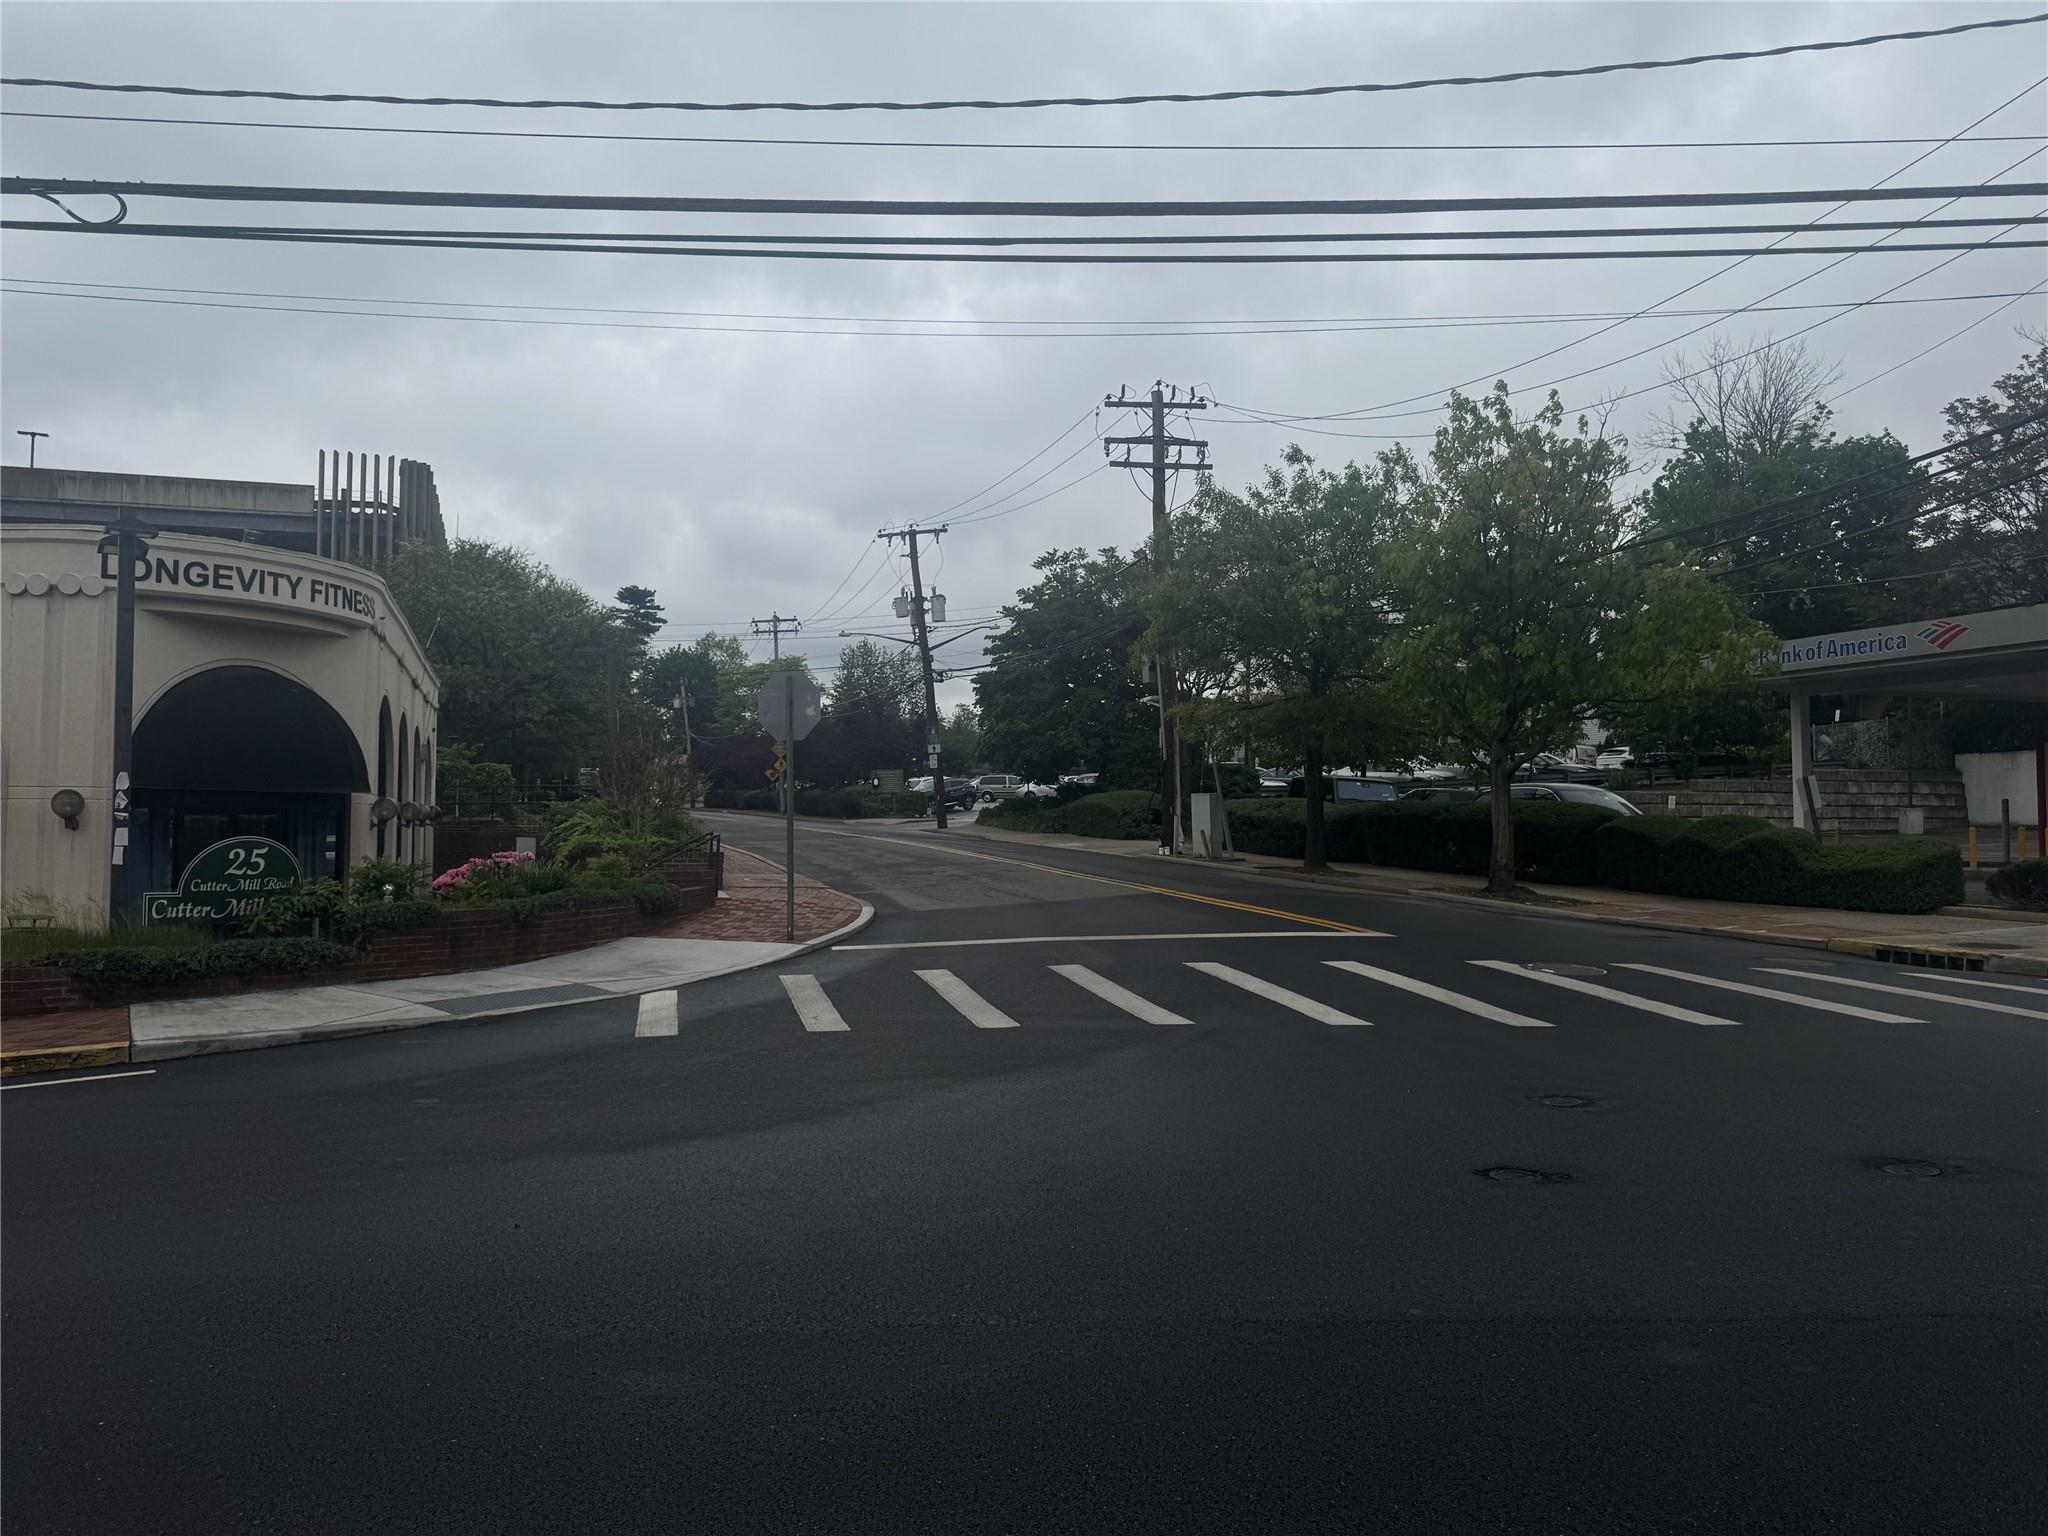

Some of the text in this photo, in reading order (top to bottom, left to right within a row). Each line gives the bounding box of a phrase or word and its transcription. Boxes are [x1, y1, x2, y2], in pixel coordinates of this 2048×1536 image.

[101, 553, 376, 619] LONGEVITY FITNESS
[1806, 640, 1823, 661] of
[1826, 632, 1907, 659] America
[224, 847, 269, 875] 25
[191, 879, 227, 892] Cutter
[227, 878, 261, 892] Mill
[152, 899, 211, 919] Cutter
